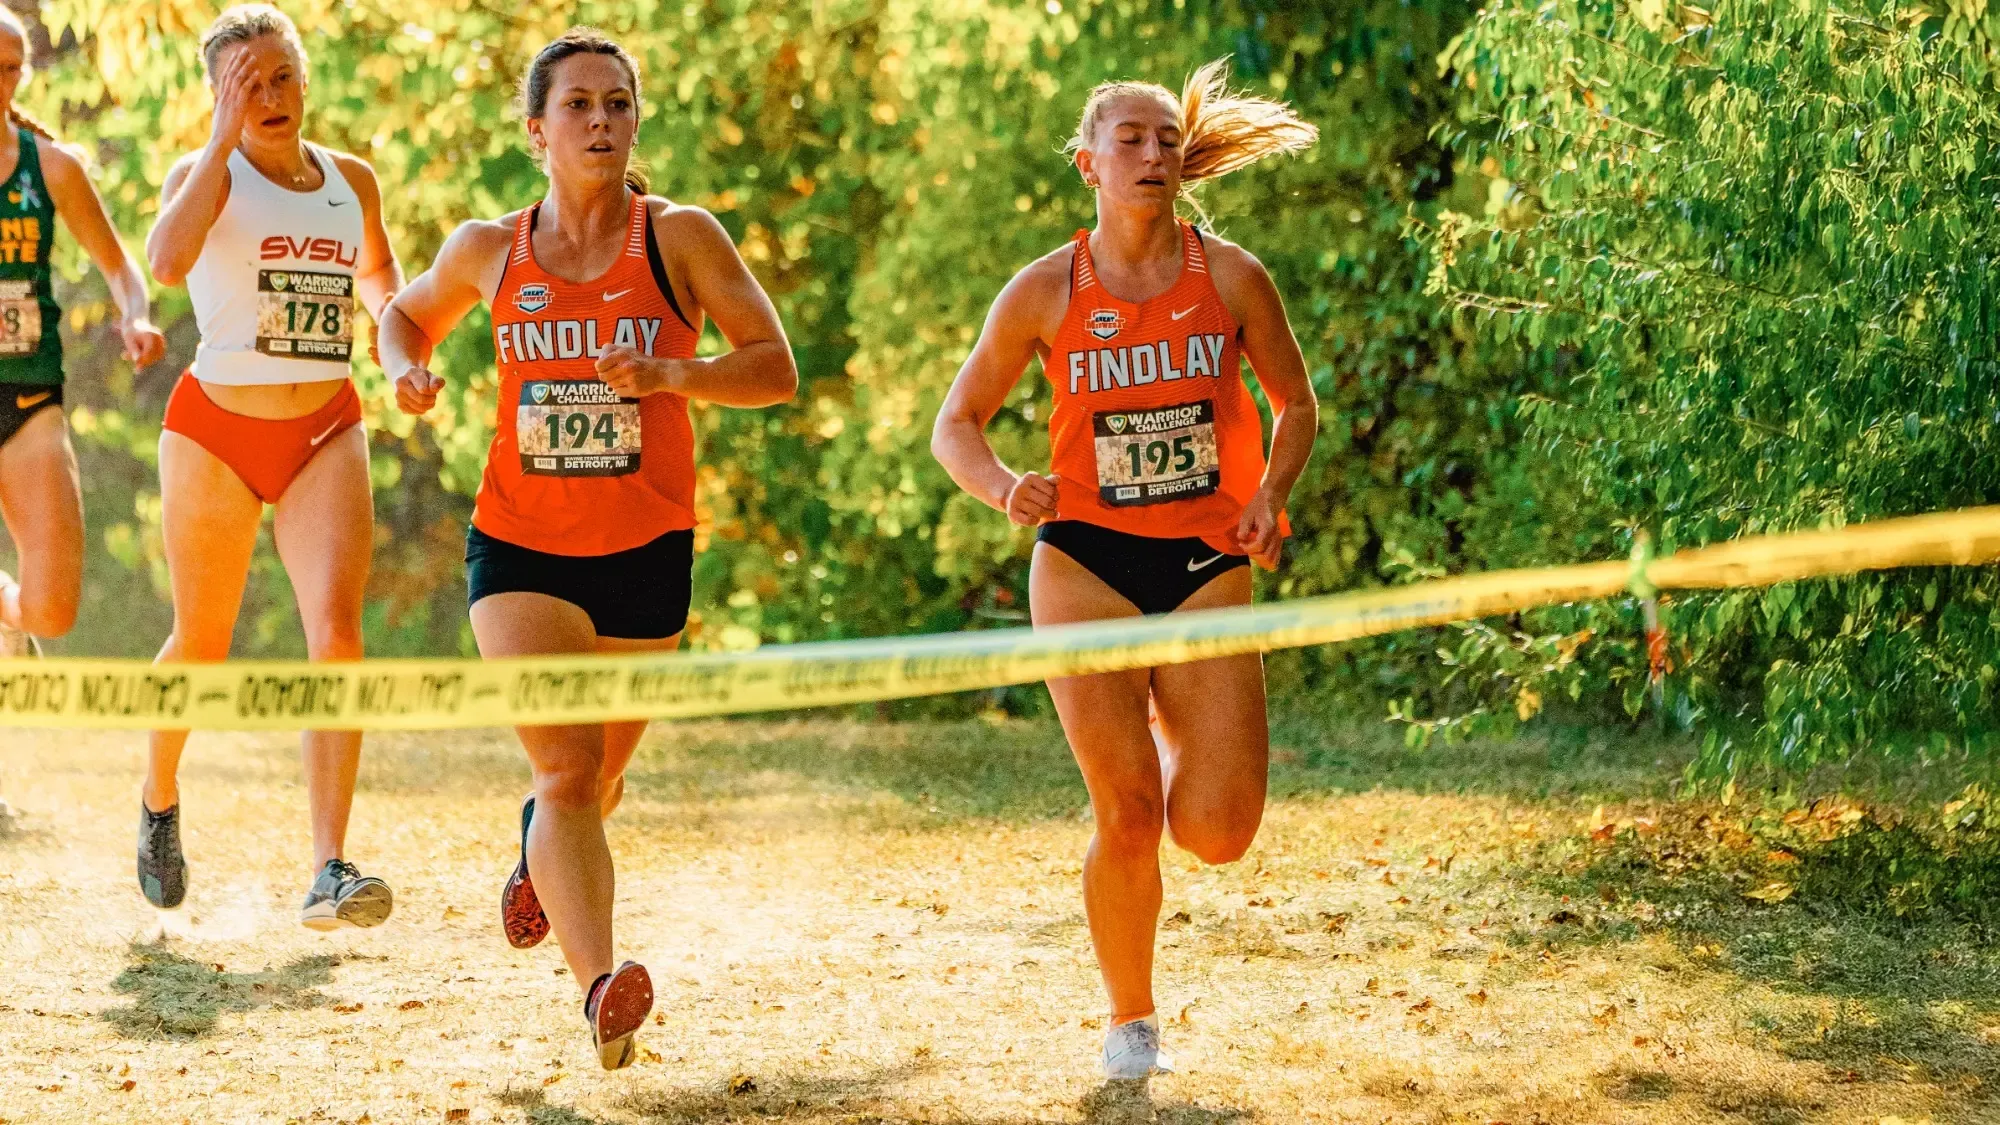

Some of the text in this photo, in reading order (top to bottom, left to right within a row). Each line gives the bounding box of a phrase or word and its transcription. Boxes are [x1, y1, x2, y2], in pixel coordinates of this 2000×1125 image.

[0, 240, 38, 263] TE
[260, 236, 358, 268] SVSU
[289, 273, 349, 290] WARRIOR
[295, 284, 345, 296] CHALLENGE
[285, 301, 340, 336] 178
[497, 317, 662, 364] FINDLAY
[1068, 333, 1225, 395] FINDLAY
[550, 384, 616, 396] WARRIO
[557, 395, 621, 404] CHALLENGE
[1127, 405, 1202, 426] WARRIOR
[1135, 416, 1197, 433] CHALLENGE
[545, 412, 619, 449] 194
[564, 459, 628, 469] DETROIT, MI
[1126, 435, 1196, 477] 195
[1148, 479, 1209, 496] DETROIT, MI
[78, 672, 191, 719] CAUTION
